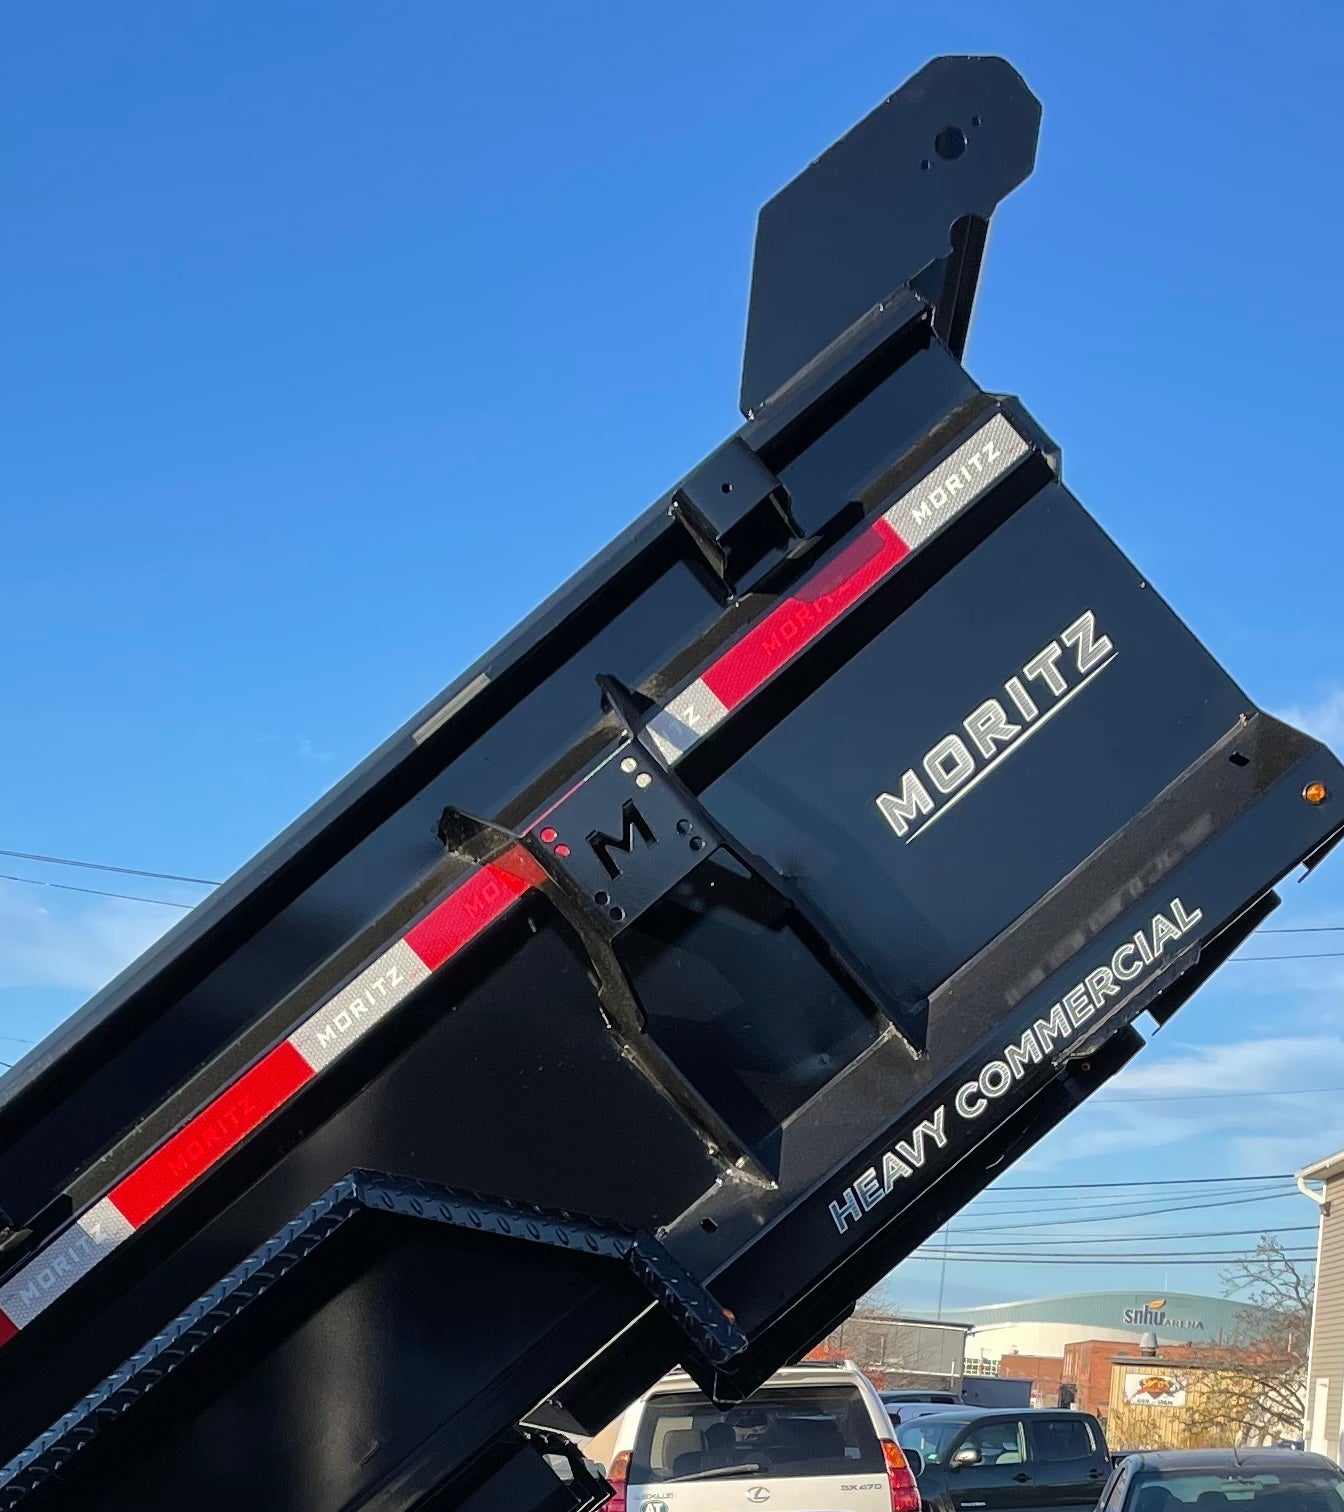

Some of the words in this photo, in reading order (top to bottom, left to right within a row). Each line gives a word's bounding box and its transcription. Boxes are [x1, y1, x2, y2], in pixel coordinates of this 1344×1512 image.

[912, 441, 998, 526] MORITZ
[875, 609, 1113, 838] MORITZ
[585, 797, 659, 880] M
[316, 965, 404, 1049] MORITZ
[828, 1105, 948, 1234] HEAVY
[955, 898, 1204, 1118] COMMERCIAL
[19, 1222, 107, 1306] MORITZ
[1123, 1303, 1166, 1326] snhu
[1162, 1320, 1204, 1330] ARENA
